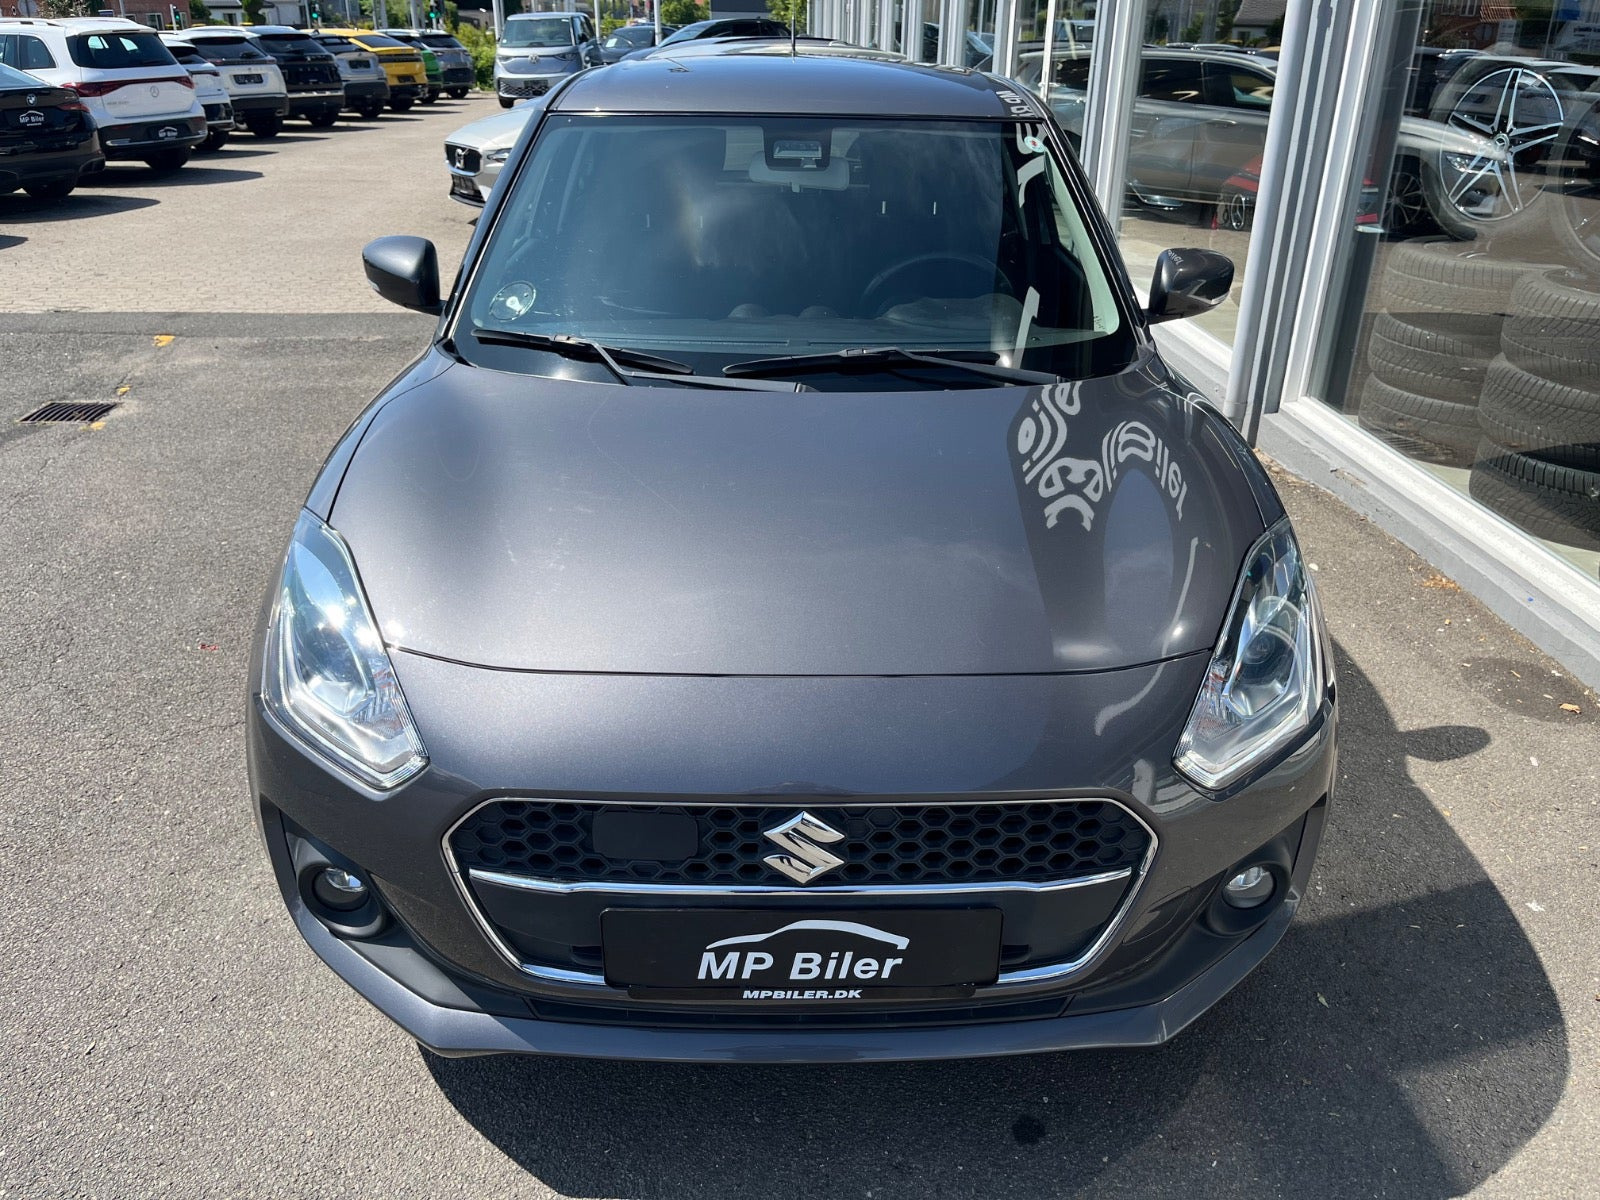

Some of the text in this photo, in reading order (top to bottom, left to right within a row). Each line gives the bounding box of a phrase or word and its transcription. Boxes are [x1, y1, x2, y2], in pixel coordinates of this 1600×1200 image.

[697, 951, 903, 980] MP Biler
[742, 989, 862, 999] MPBILER.DK
